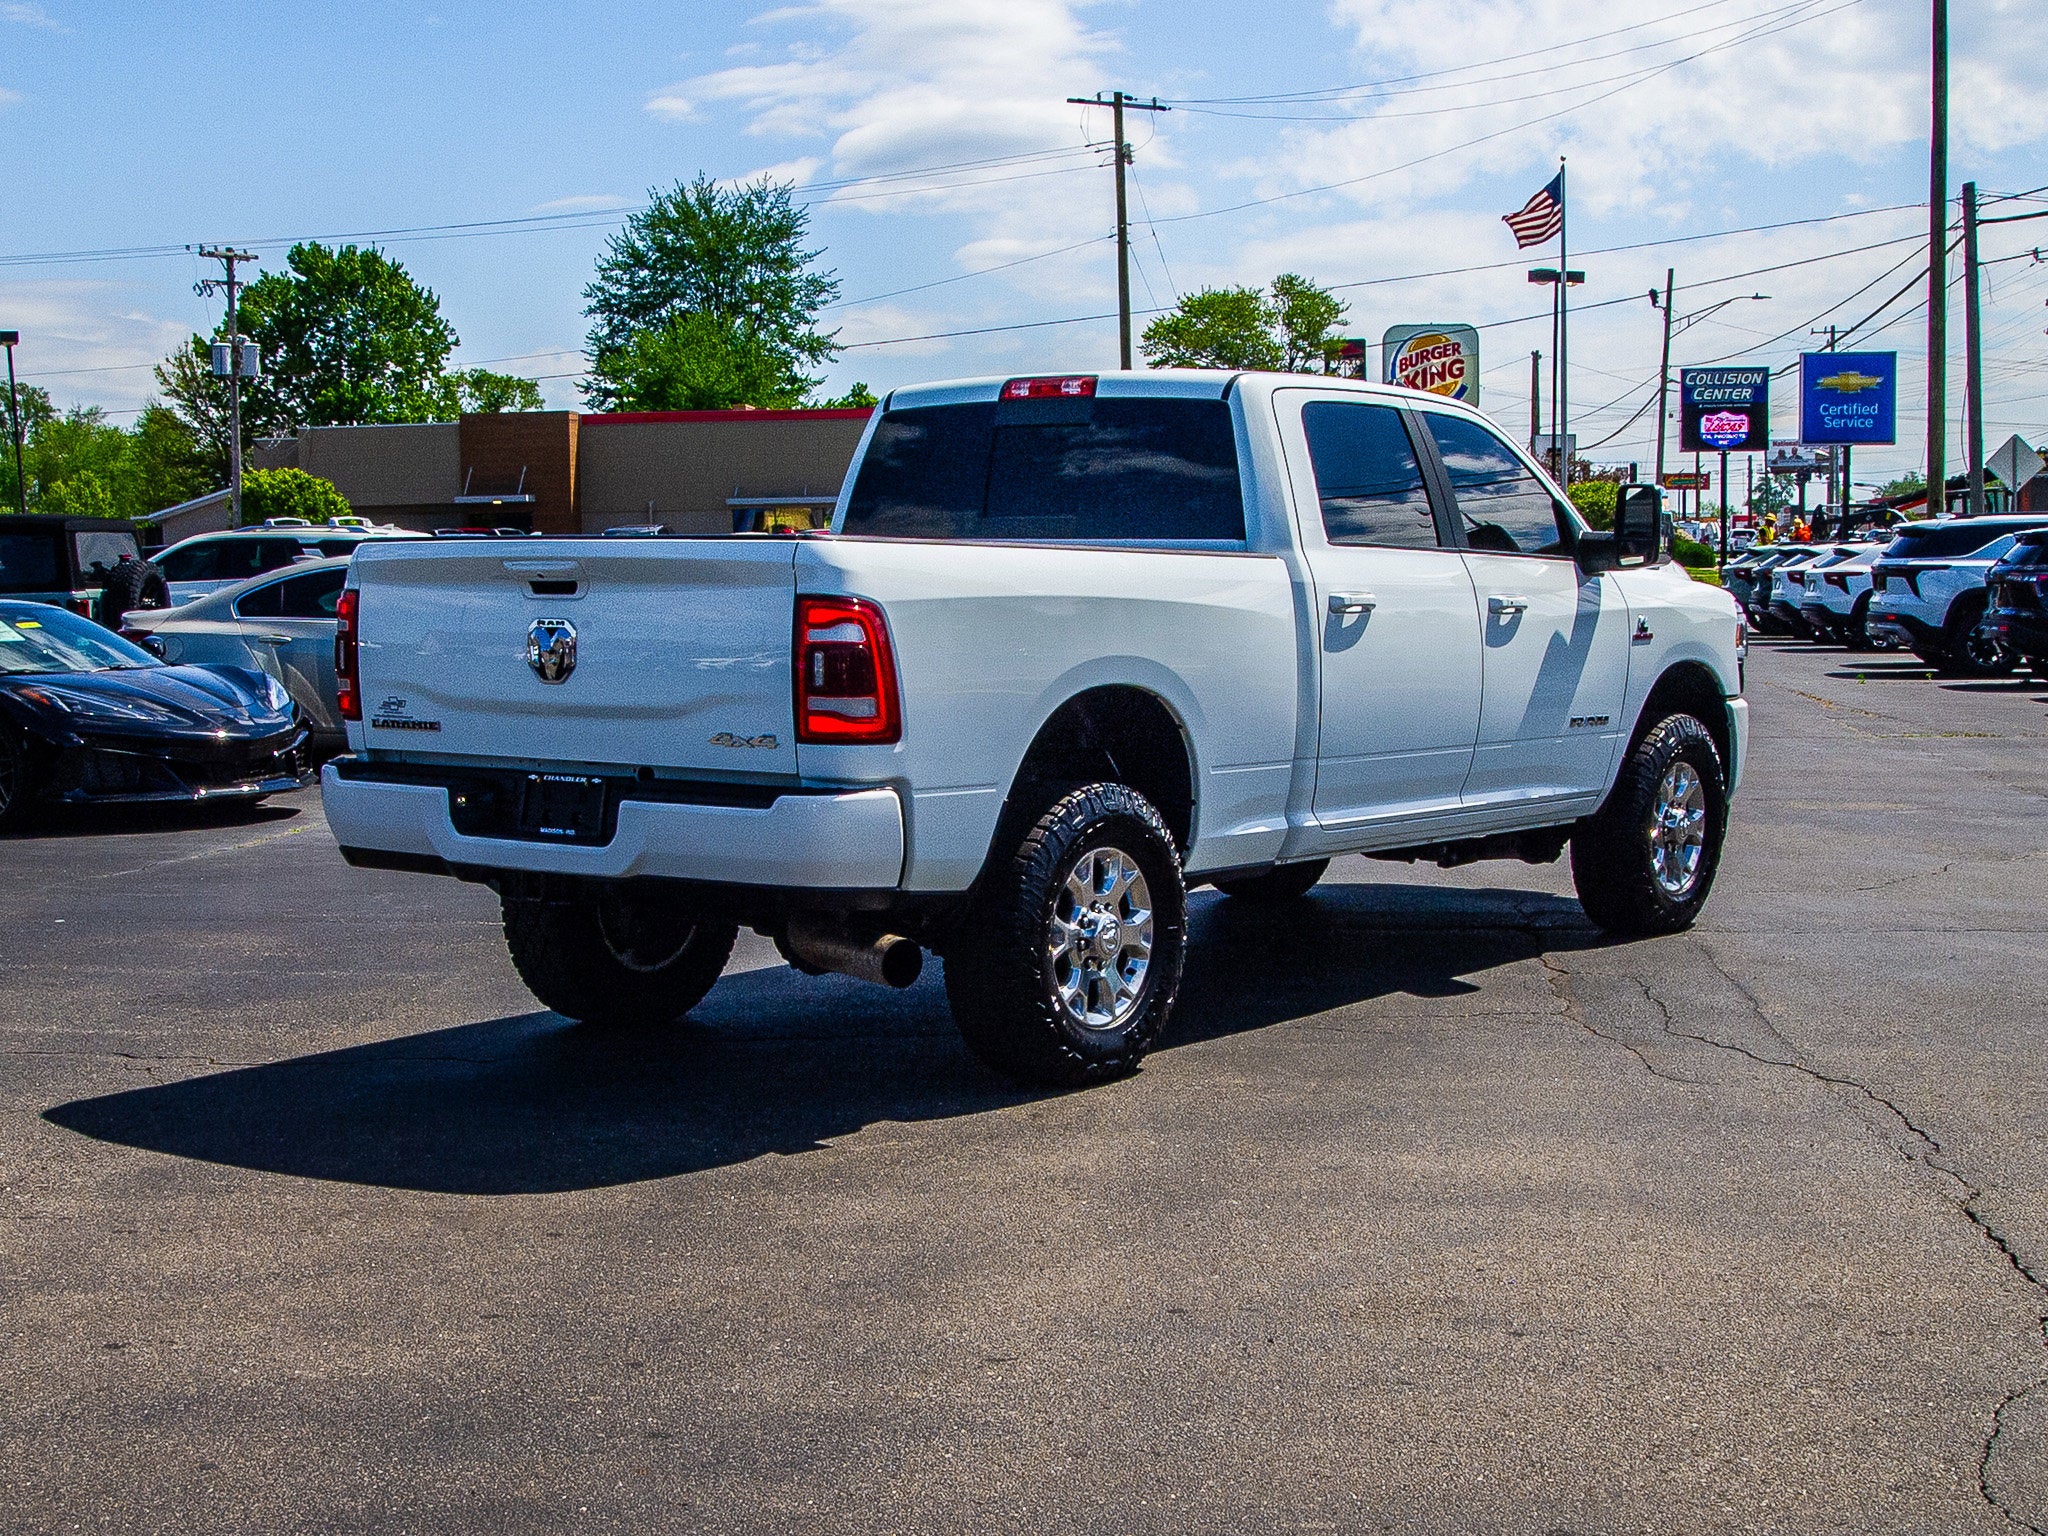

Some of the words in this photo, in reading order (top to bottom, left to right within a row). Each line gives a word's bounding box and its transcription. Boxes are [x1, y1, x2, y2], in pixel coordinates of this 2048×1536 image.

[1399, 341, 1462, 375] BURGER
[1403, 358, 1465, 390] KING
[1685, 372, 1763, 385] COLLISION
[1693, 387, 1752, 400] CENTER
[1820, 403, 1879, 415] Certified
[1824, 416, 1874, 428] Service
[371, 719, 442, 732] LARAMIE
[1570, 715, 1609, 727] RAM
[543, 775, 588, 783] CHANDLER
